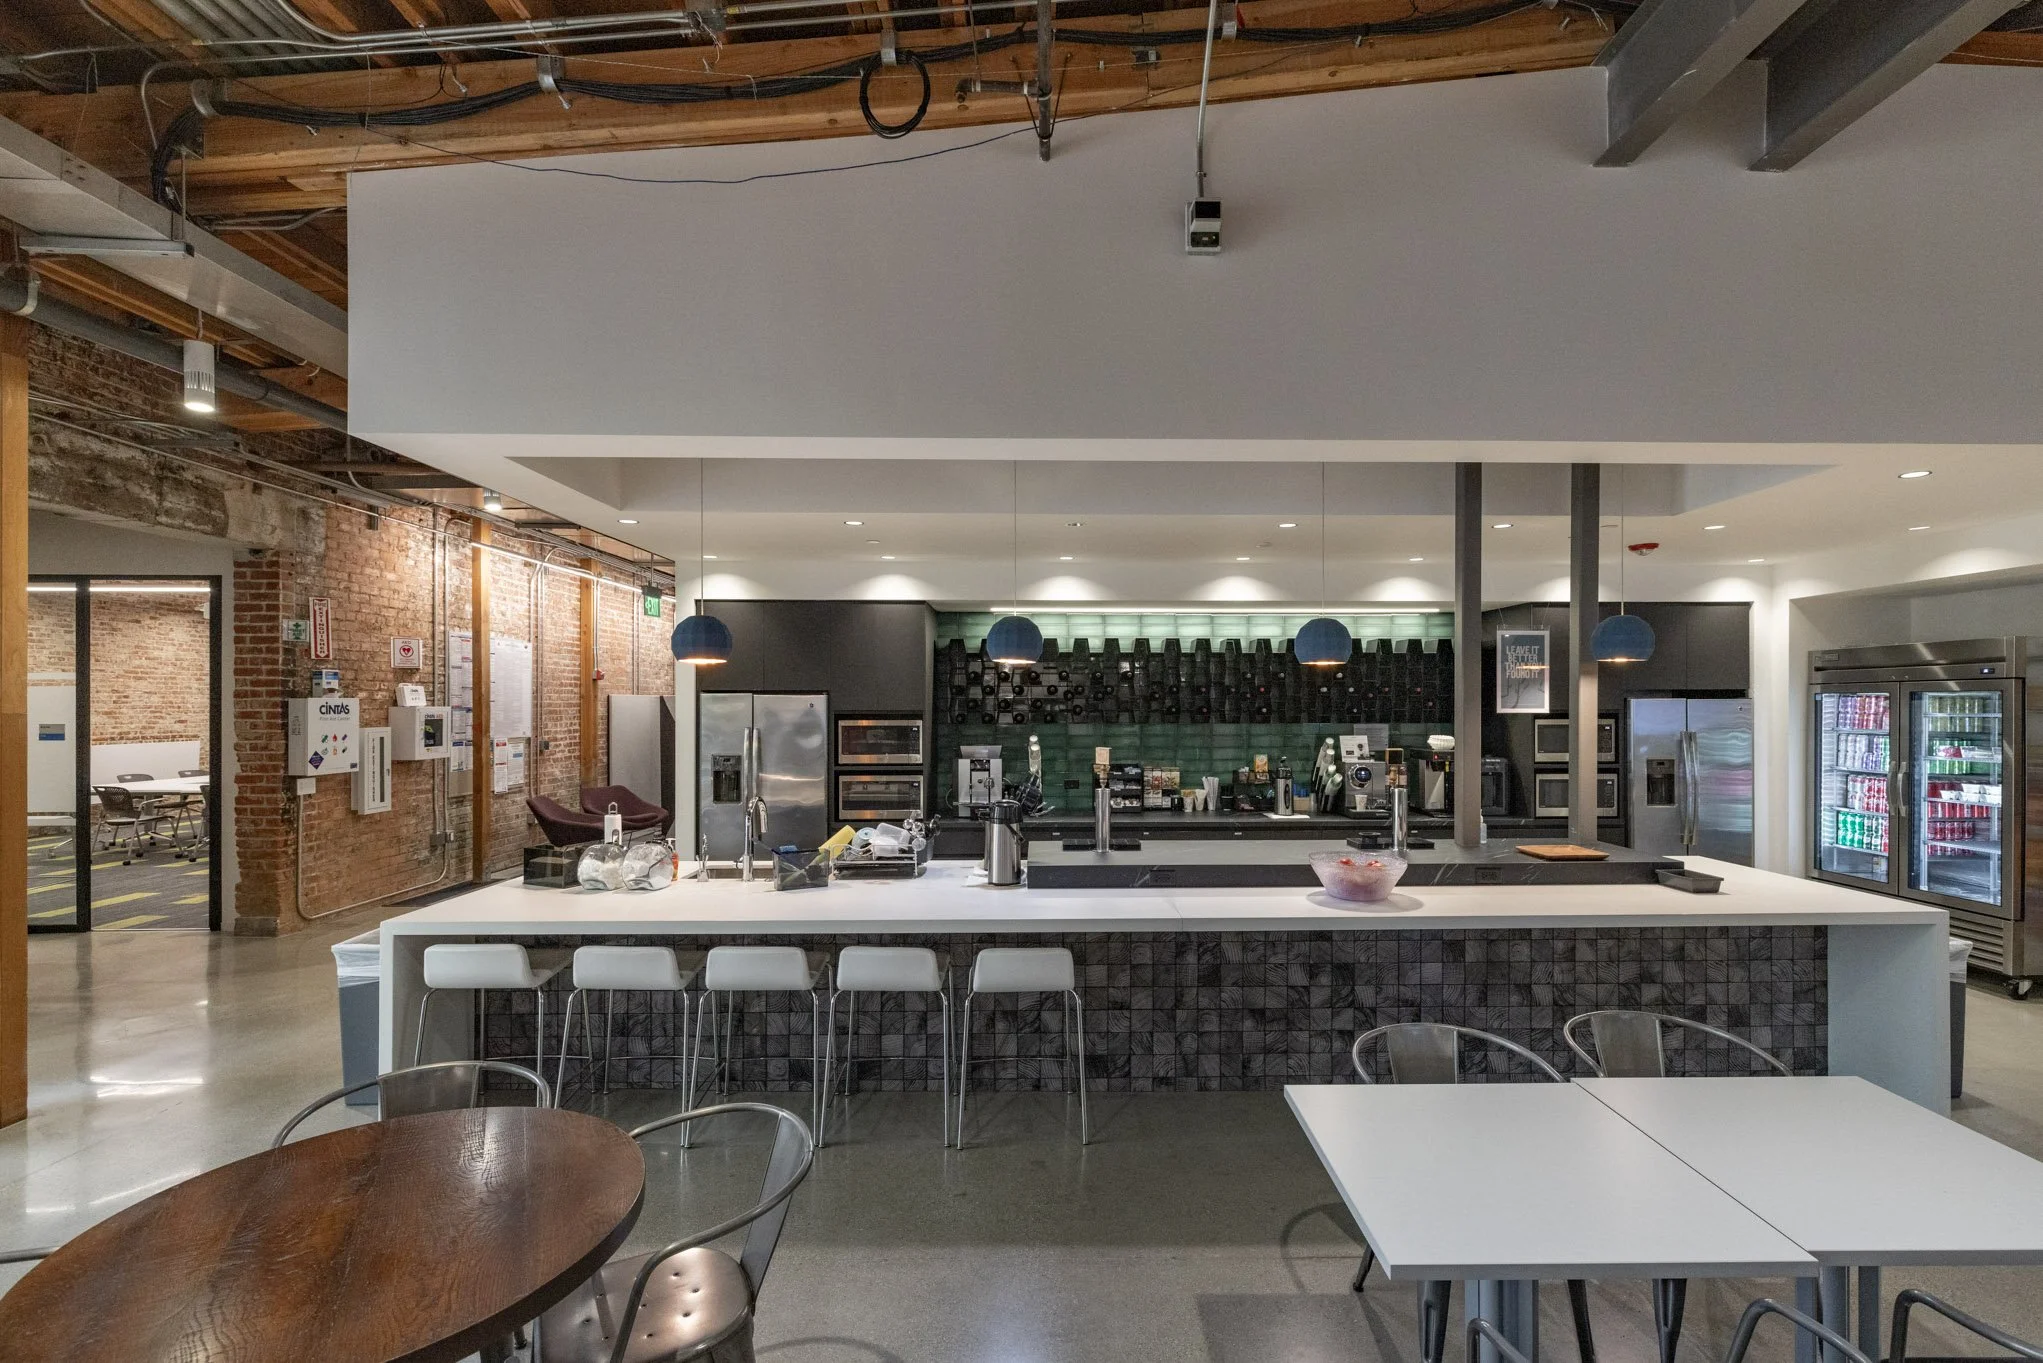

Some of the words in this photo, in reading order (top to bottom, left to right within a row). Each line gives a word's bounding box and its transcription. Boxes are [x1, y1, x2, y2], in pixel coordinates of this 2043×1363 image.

[648, 596, 659, 615] EXIT
[1506, 646, 1530, 654] LEAVE
[1531, 646, 1540, 654] IT
[1508, 654, 1538, 662] BETTER
[1506, 670, 1530, 678] FOUND
[1531, 670, 1539, 678] IT
